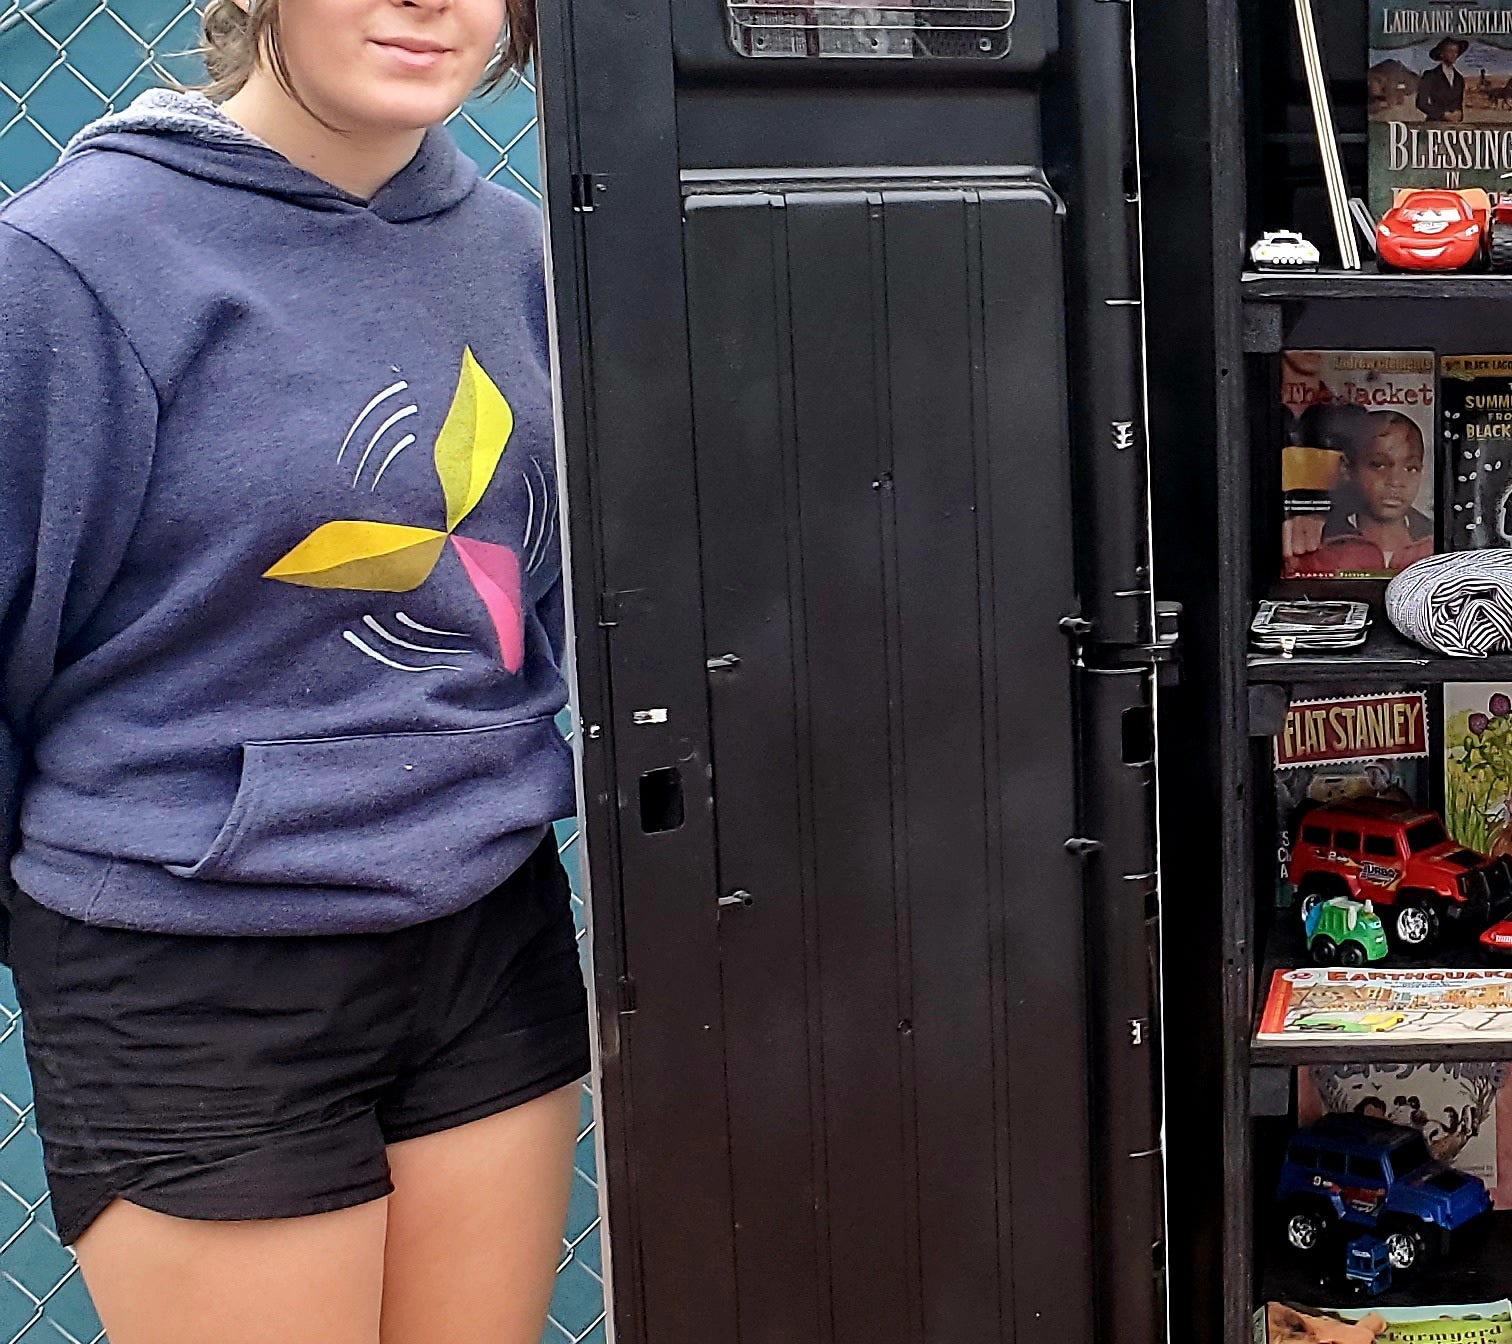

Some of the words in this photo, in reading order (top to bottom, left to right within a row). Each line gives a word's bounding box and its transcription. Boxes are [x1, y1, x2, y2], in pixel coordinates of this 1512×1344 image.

[1383, 8, 1453, 34] LAURAINE
[1446, 171, 1460, 188] IN
[1464, 360, 1489, 370] BLACK
[1340, 381, 1433, 405] Jacket
[1466, 423, 1511, 439] BLACK
[1283, 709, 1327, 758] FLAT
[1329, 701, 1421, 752] STANLEY
[1388, 1324, 1503, 1343] Farmyard
